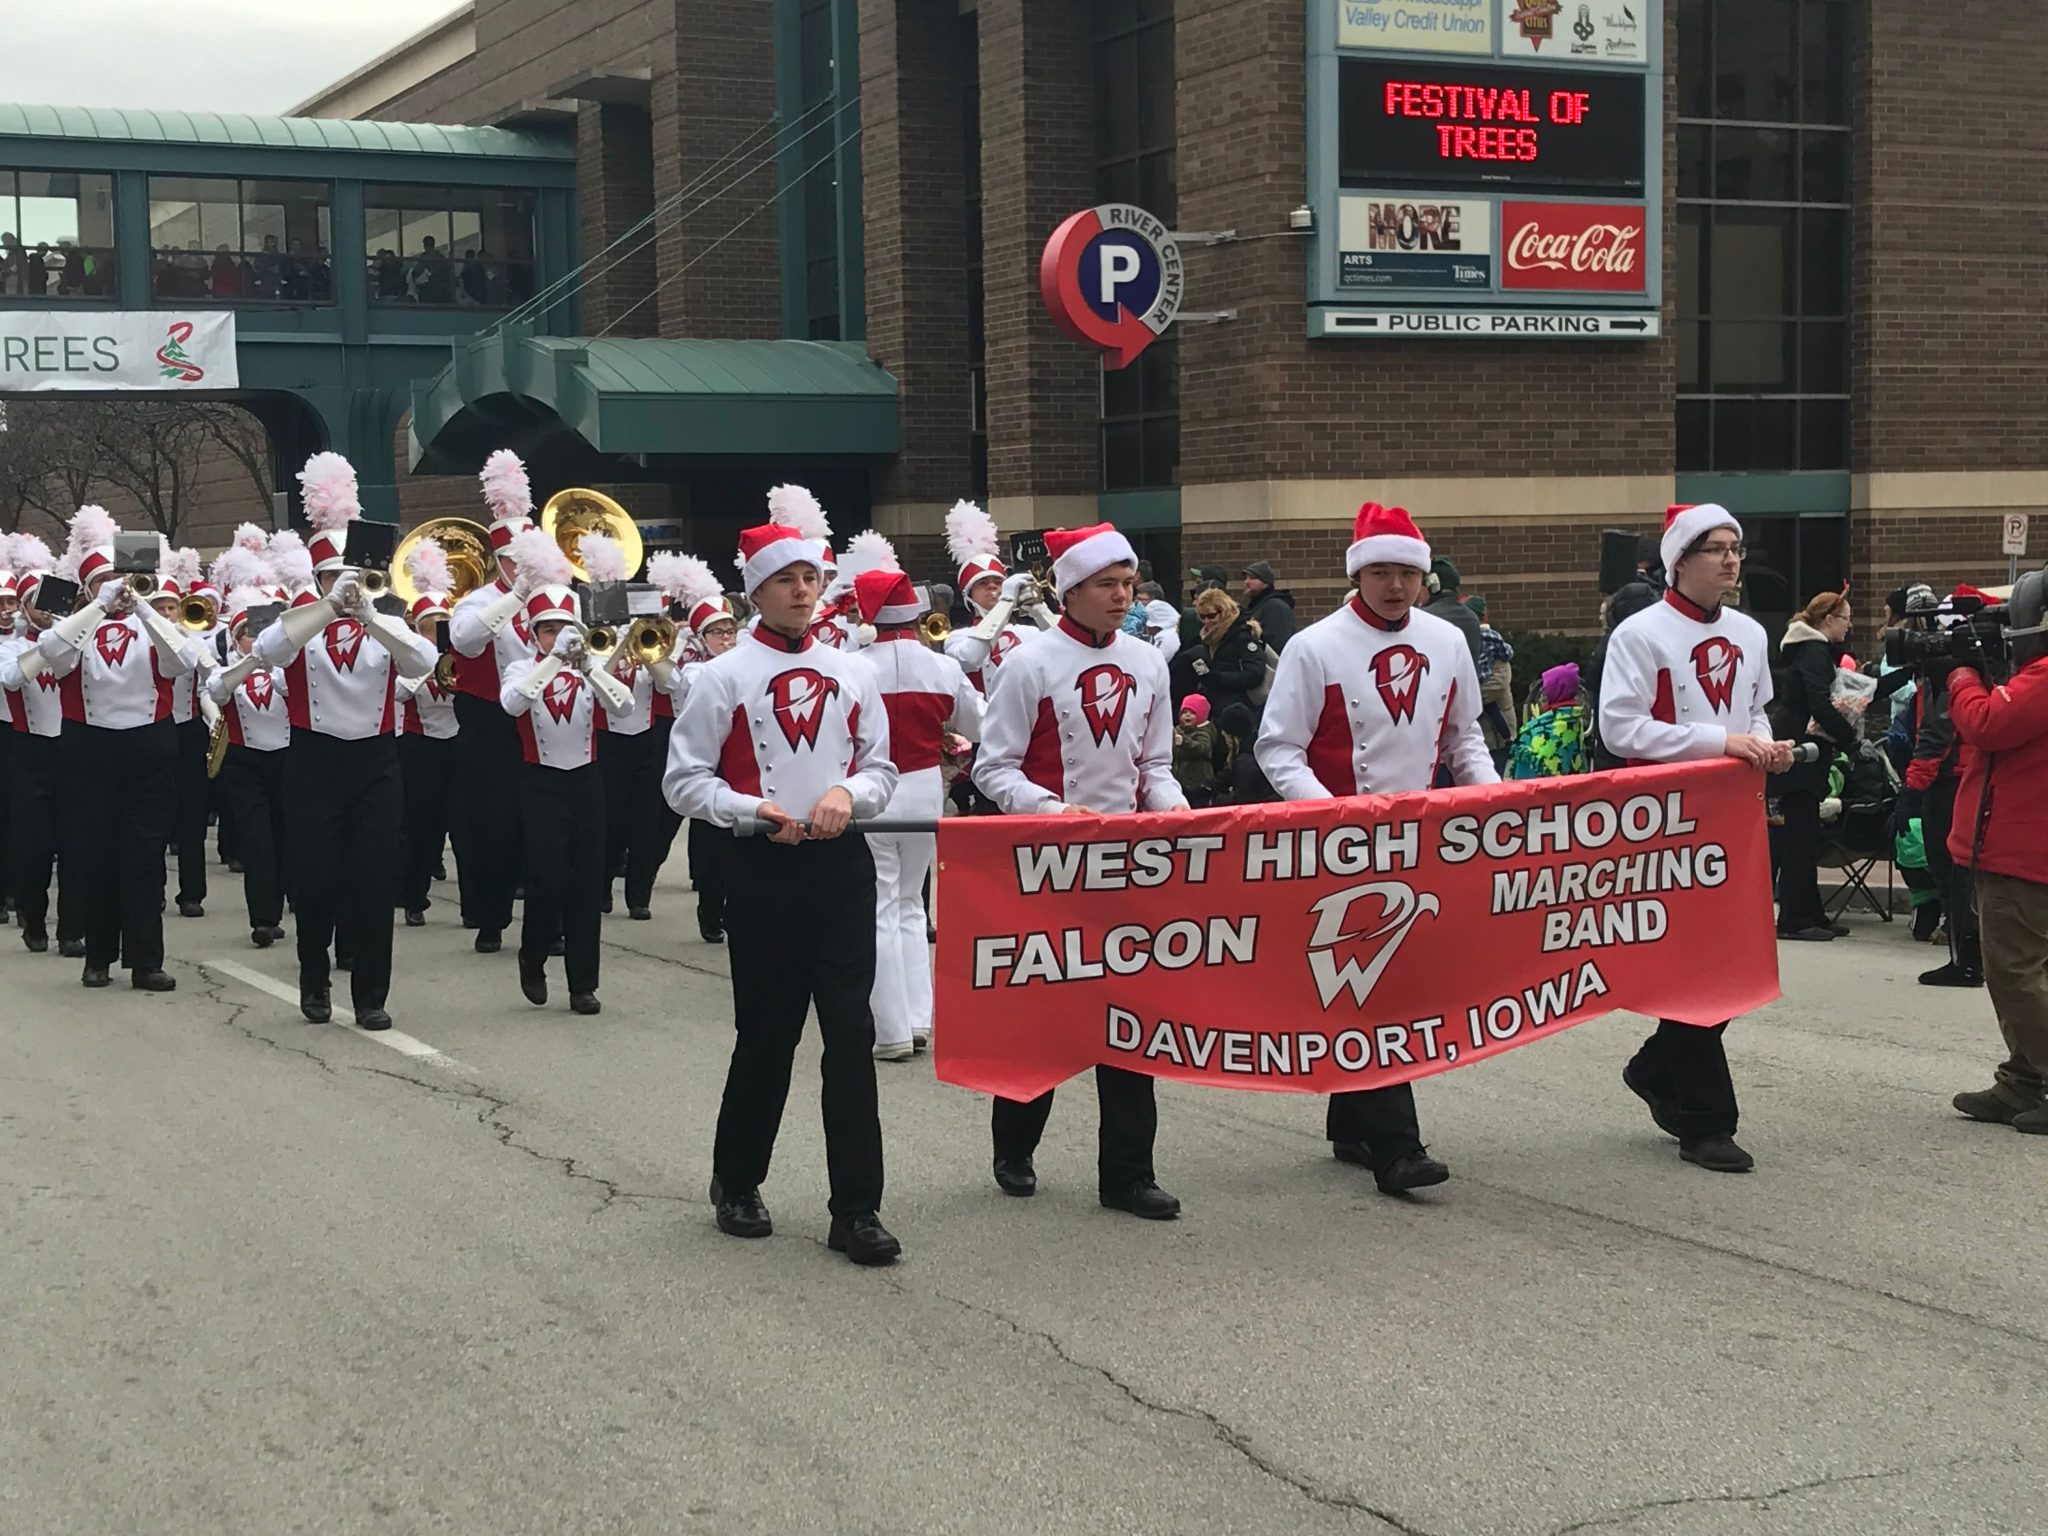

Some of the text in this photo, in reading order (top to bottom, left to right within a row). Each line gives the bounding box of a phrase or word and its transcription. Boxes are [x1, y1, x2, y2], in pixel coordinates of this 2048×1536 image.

[1346, 7, 1486, 33] Valley Credit Union
[1385, 81, 1590, 124] FESTIVAL OF
[1435, 124, 1538, 161] TREES
[1368, 202, 1461, 251] MORE
[1508, 222, 1640, 273] Coca-Cola
[1099, 244, 1141, 304] P
[1110, 208, 1181, 325] RIVER CENTER
[1344, 255, 1373, 265] ARTS
[1389, 315, 1600, 332] PUBLIC PARKING
[4, 336, 120, 372] REES
[1014, 790, 1698, 896] WEST HIGH SCHOOL
[1491, 843, 1728, 915] MARCHING
[1541, 898, 1668, 952] BAND
[972, 915, 1260, 989] FALCON
[1106, 960, 1610, 1076] DAVENPORT, IOWA
